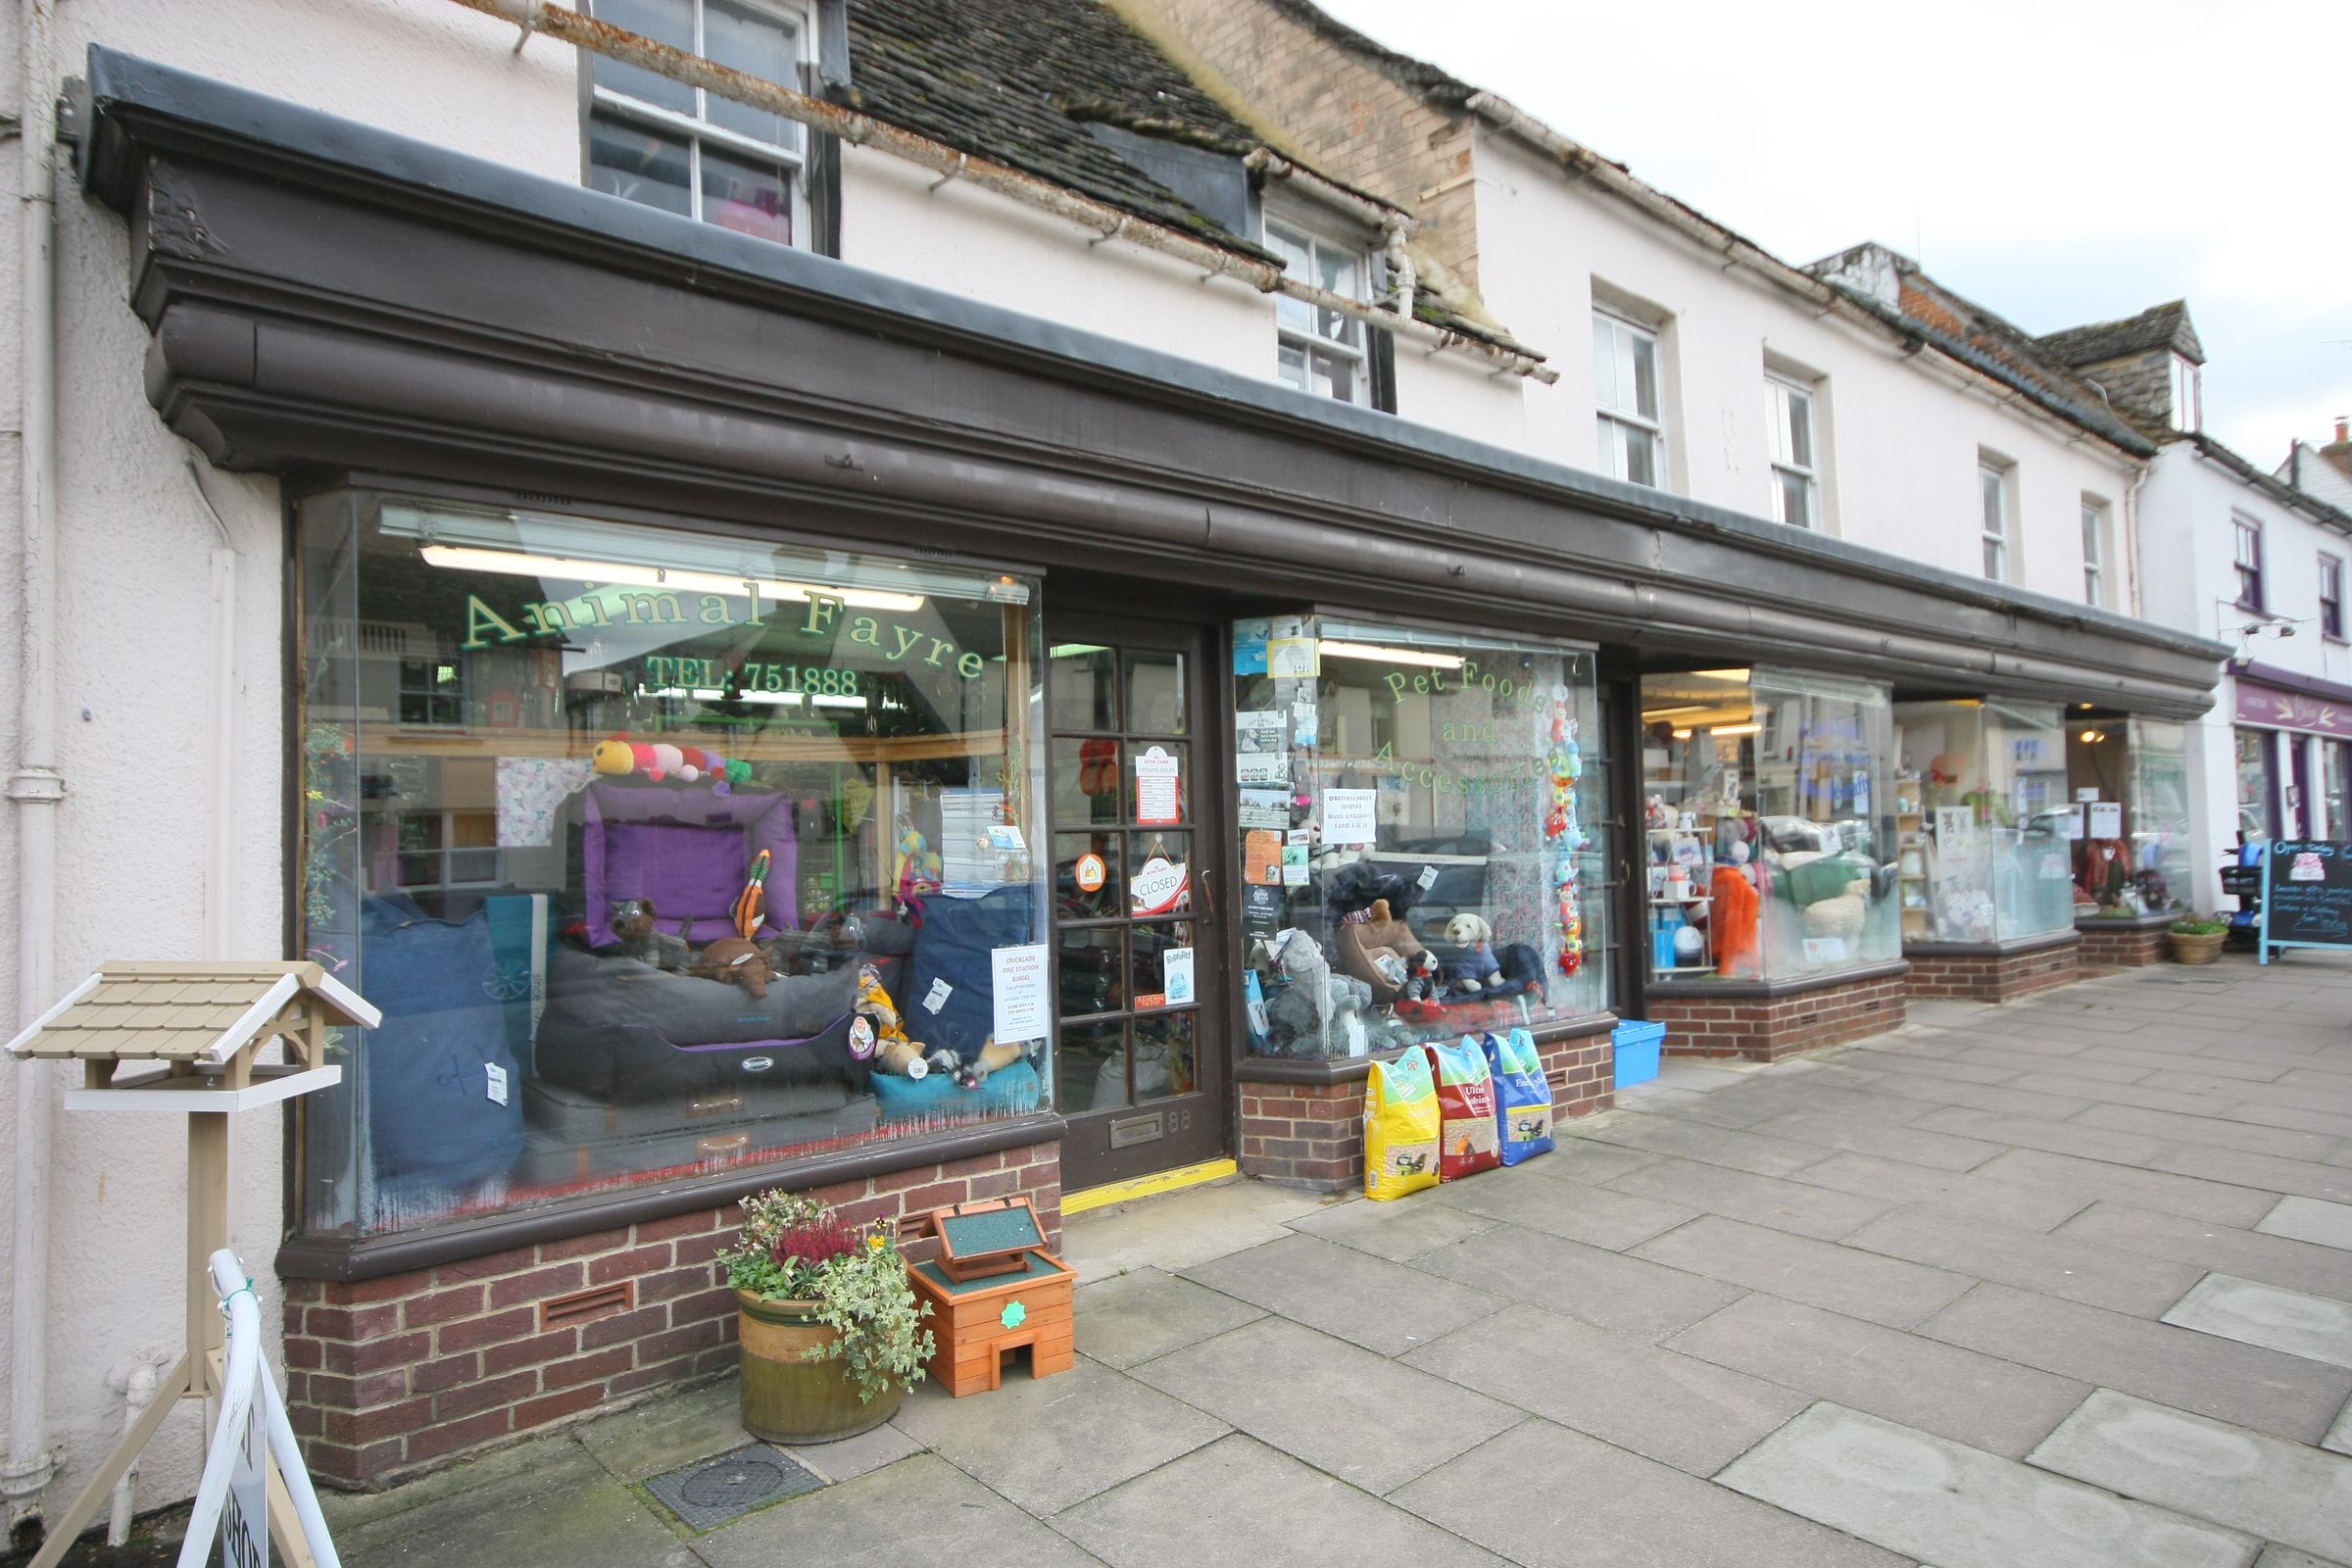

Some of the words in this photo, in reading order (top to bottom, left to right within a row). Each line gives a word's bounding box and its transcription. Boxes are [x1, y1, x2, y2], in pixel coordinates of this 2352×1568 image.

[461, 581, 763, 652] Animal
[800, 588, 986, 681] Fayre
[645, 656, 735, 693] TEL:
[744, 662, 858, 698] 751888
[1383, 666, 1446, 704] Pet
[1460, 661, 1547, 714] Foods
[1442, 716, 1499, 744] and
[1372, 740, 1560, 797] Accessories
[1140, 876, 1178, 896] CLOSED
[1167, 1109, 1192, 1134] 88
